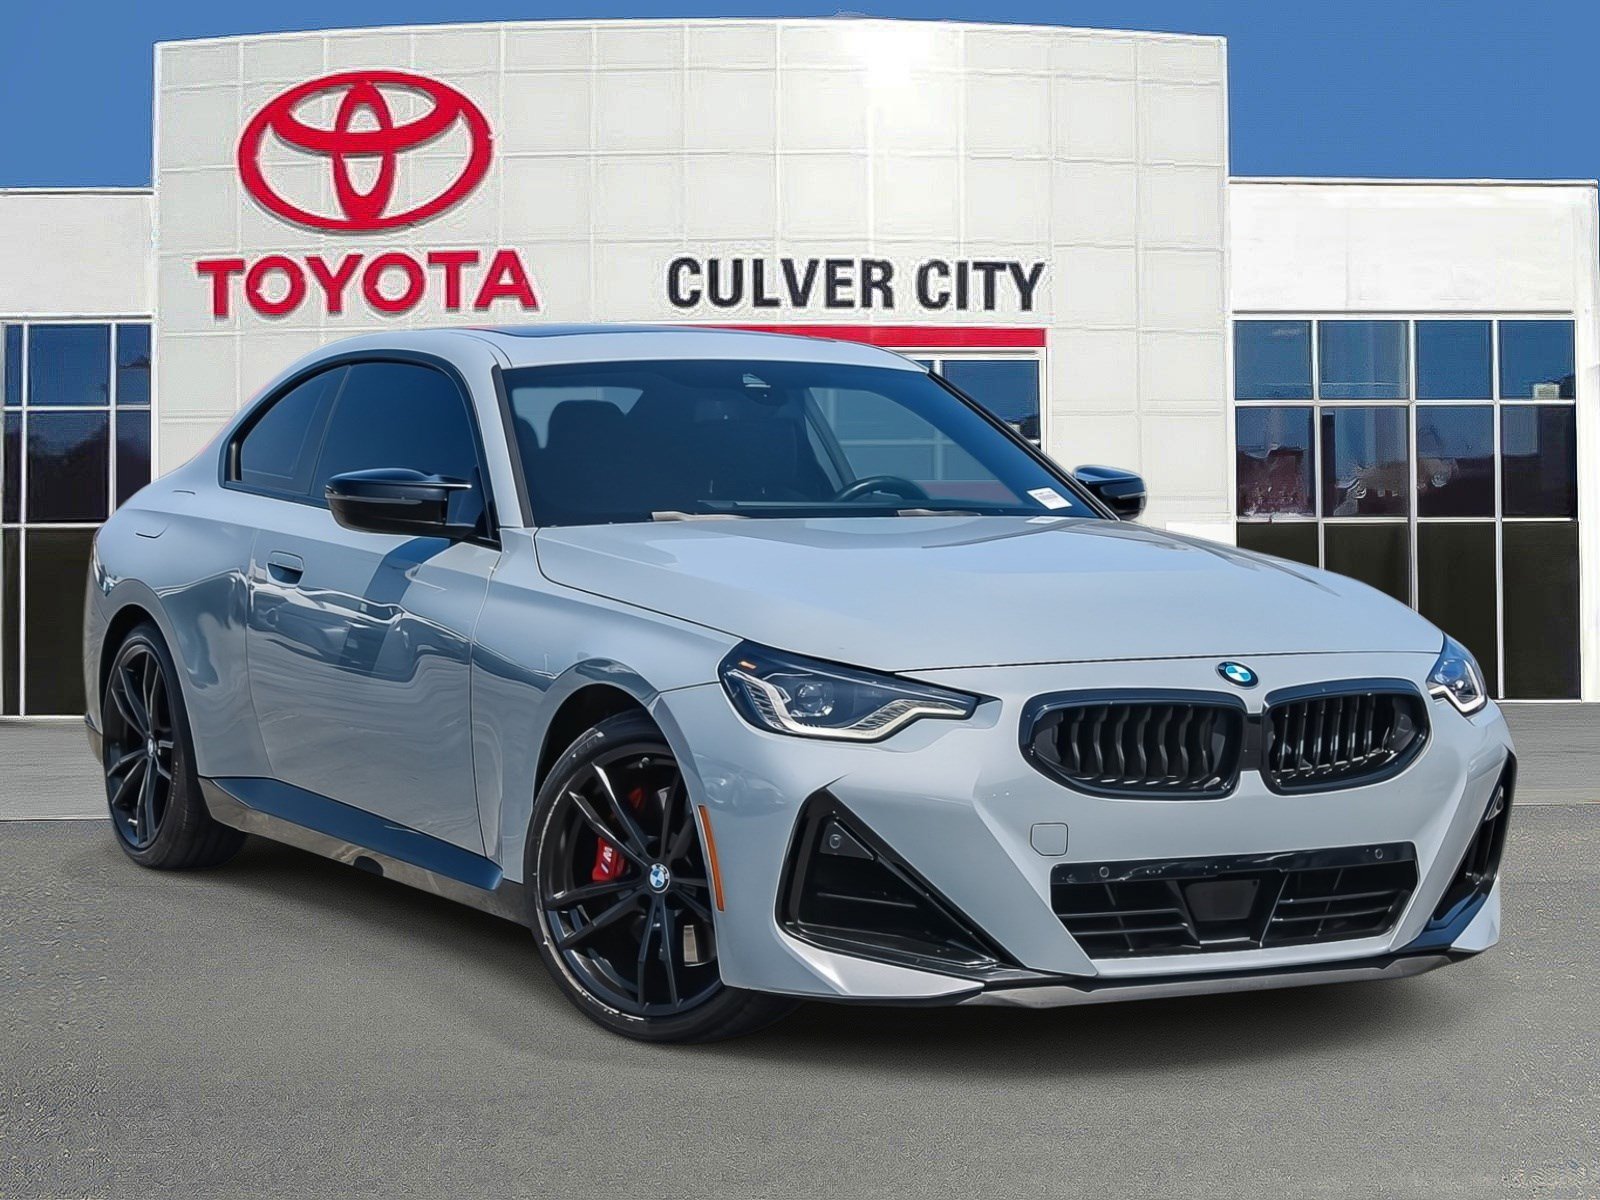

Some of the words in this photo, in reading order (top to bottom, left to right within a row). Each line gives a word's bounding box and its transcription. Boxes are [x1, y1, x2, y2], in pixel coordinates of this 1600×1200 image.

[195, 249, 540, 318] TOYOTA
[667, 257, 895, 309] CULVER
[915, 258, 1046, 311] CITY
